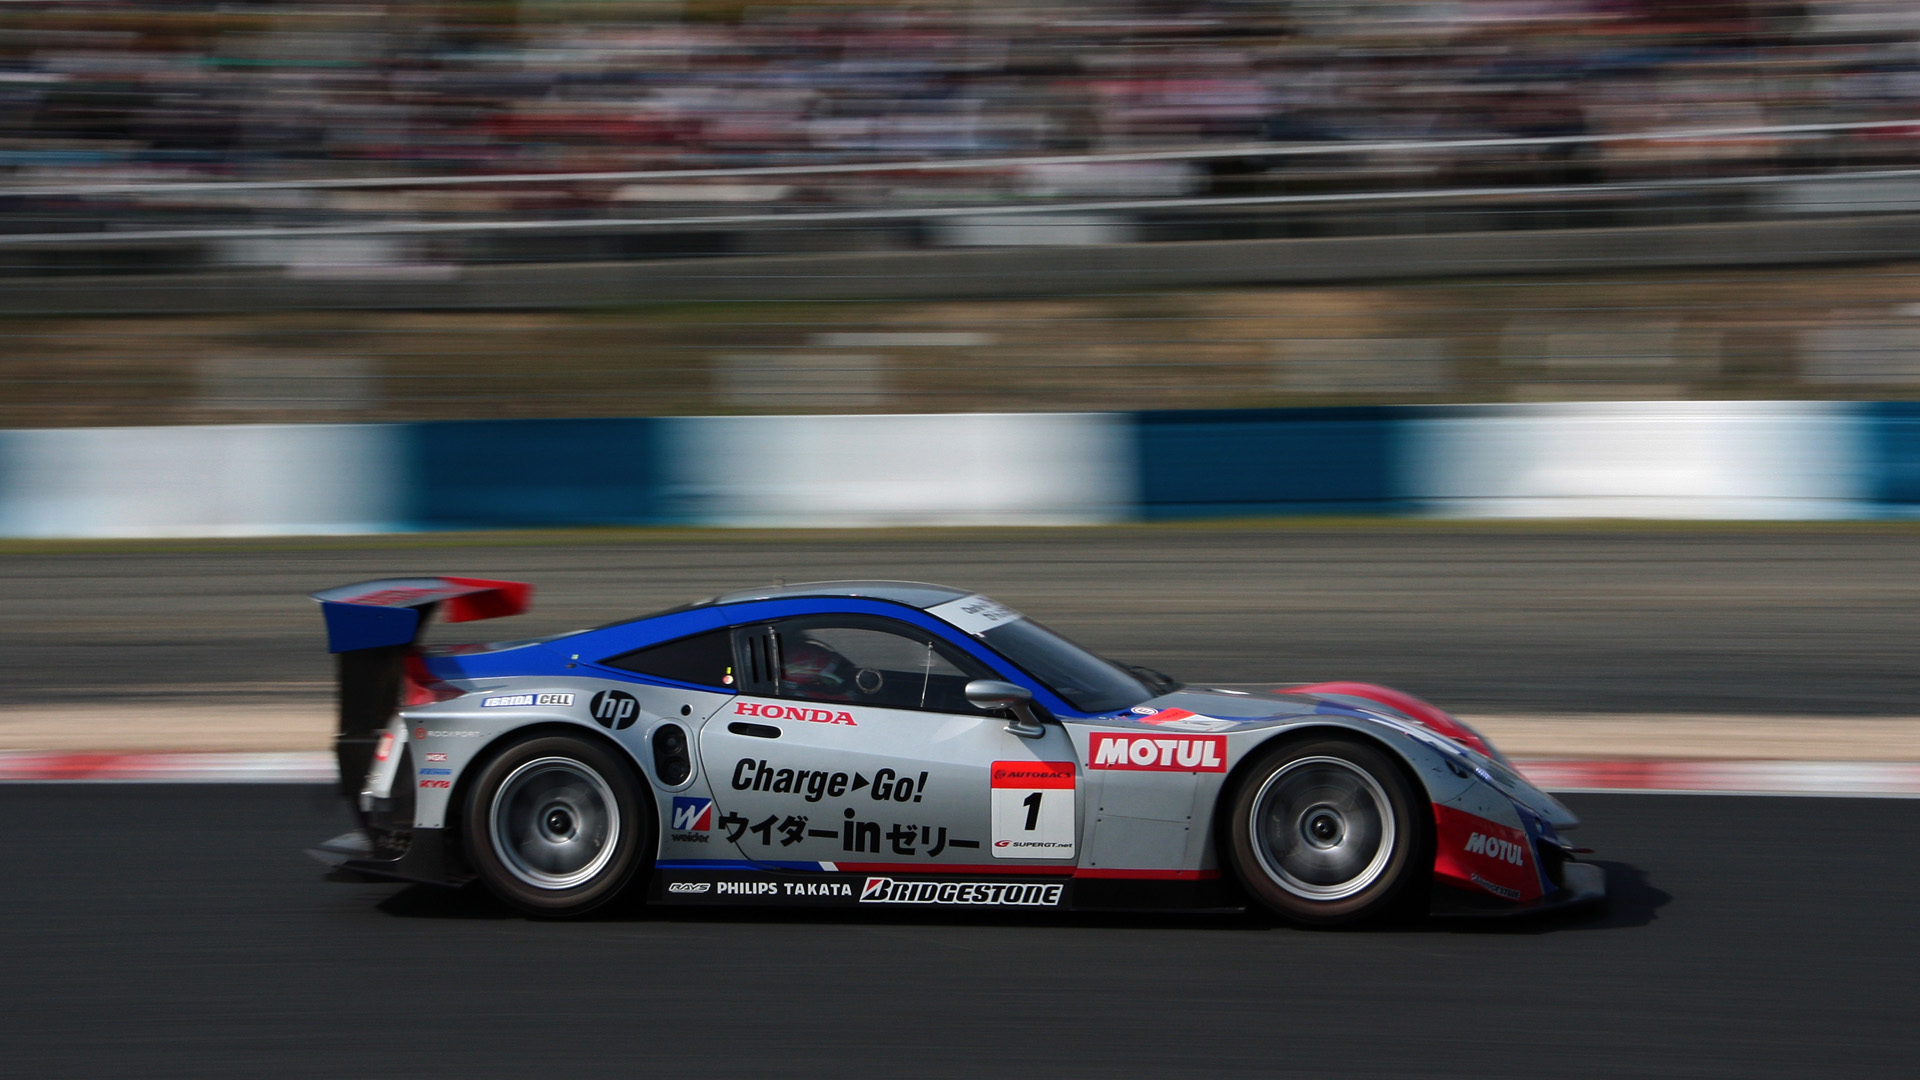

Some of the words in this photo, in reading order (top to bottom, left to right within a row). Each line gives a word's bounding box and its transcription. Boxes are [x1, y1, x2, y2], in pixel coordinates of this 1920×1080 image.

[539, 695, 570, 704] CELL
[593, 690, 637, 730] hp
[734, 702, 858, 726] HONDA
[1094, 738, 1221, 767] MOTUL
[731, 758, 849, 803] Charge
[871, 768, 929, 803] Go!
[1023, 793, 1043, 831] 1
[672, 833, 710, 843] weider
[718, 808, 980, 857] ウイダーinゼリー
[1464, 832, 1524, 867] MOTUL
[668, 882, 711, 893] RAYS
[717, 882, 778, 895] PHILIPS
[784, 883, 852, 896] TAKATA
[859, 877, 1064, 906] BRIDGESTONE
[1471, 873, 1521, 899] BGESTONE
